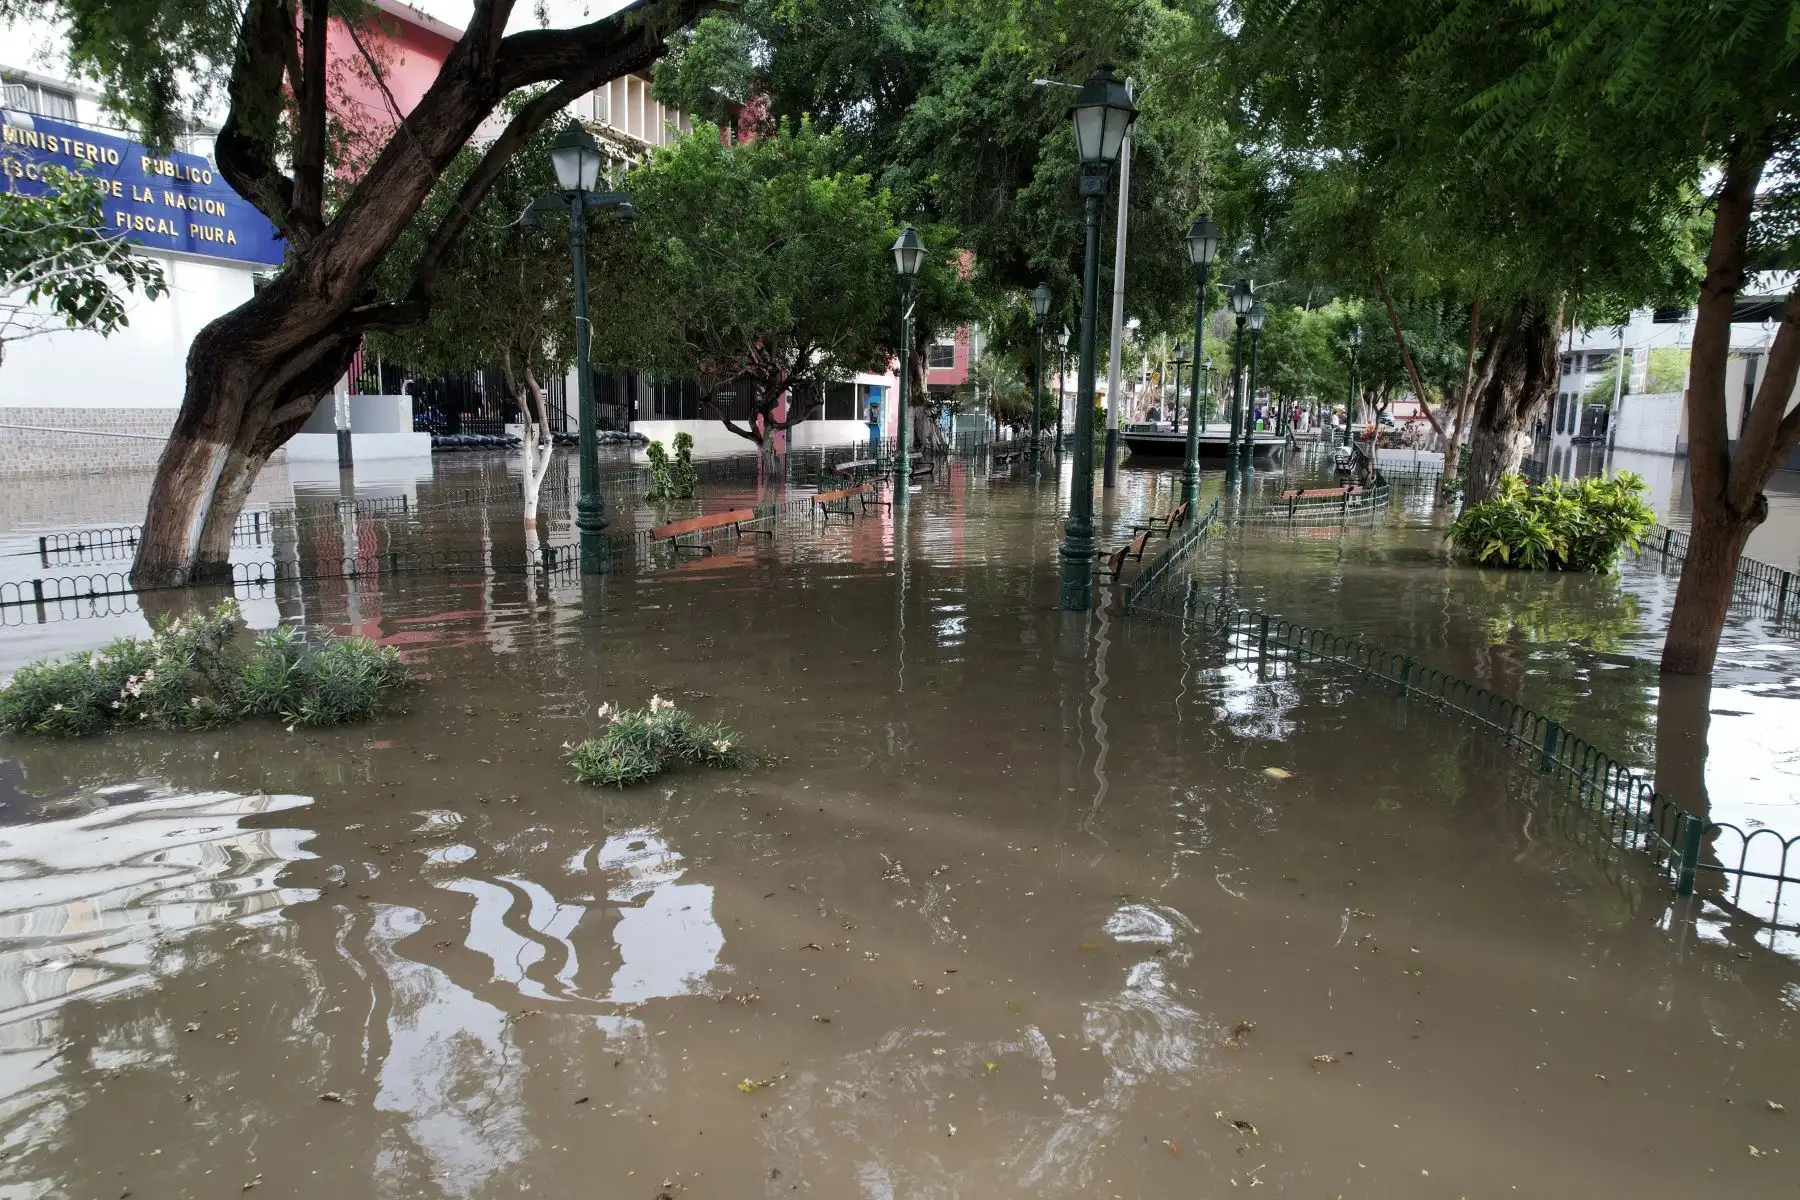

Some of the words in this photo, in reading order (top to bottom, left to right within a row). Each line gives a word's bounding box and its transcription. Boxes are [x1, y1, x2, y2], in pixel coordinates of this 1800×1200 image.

[3, 124, 119, 165] MINISTERIO
[141, 156, 212, 185] PUBLICO
[99, 178, 123, 198] DE
[132, 185, 154, 203] LA
[164, 190, 225, 217] NACION
[115, 211, 179, 236] FISCAL
[190, 223, 237, 245] PIURA
